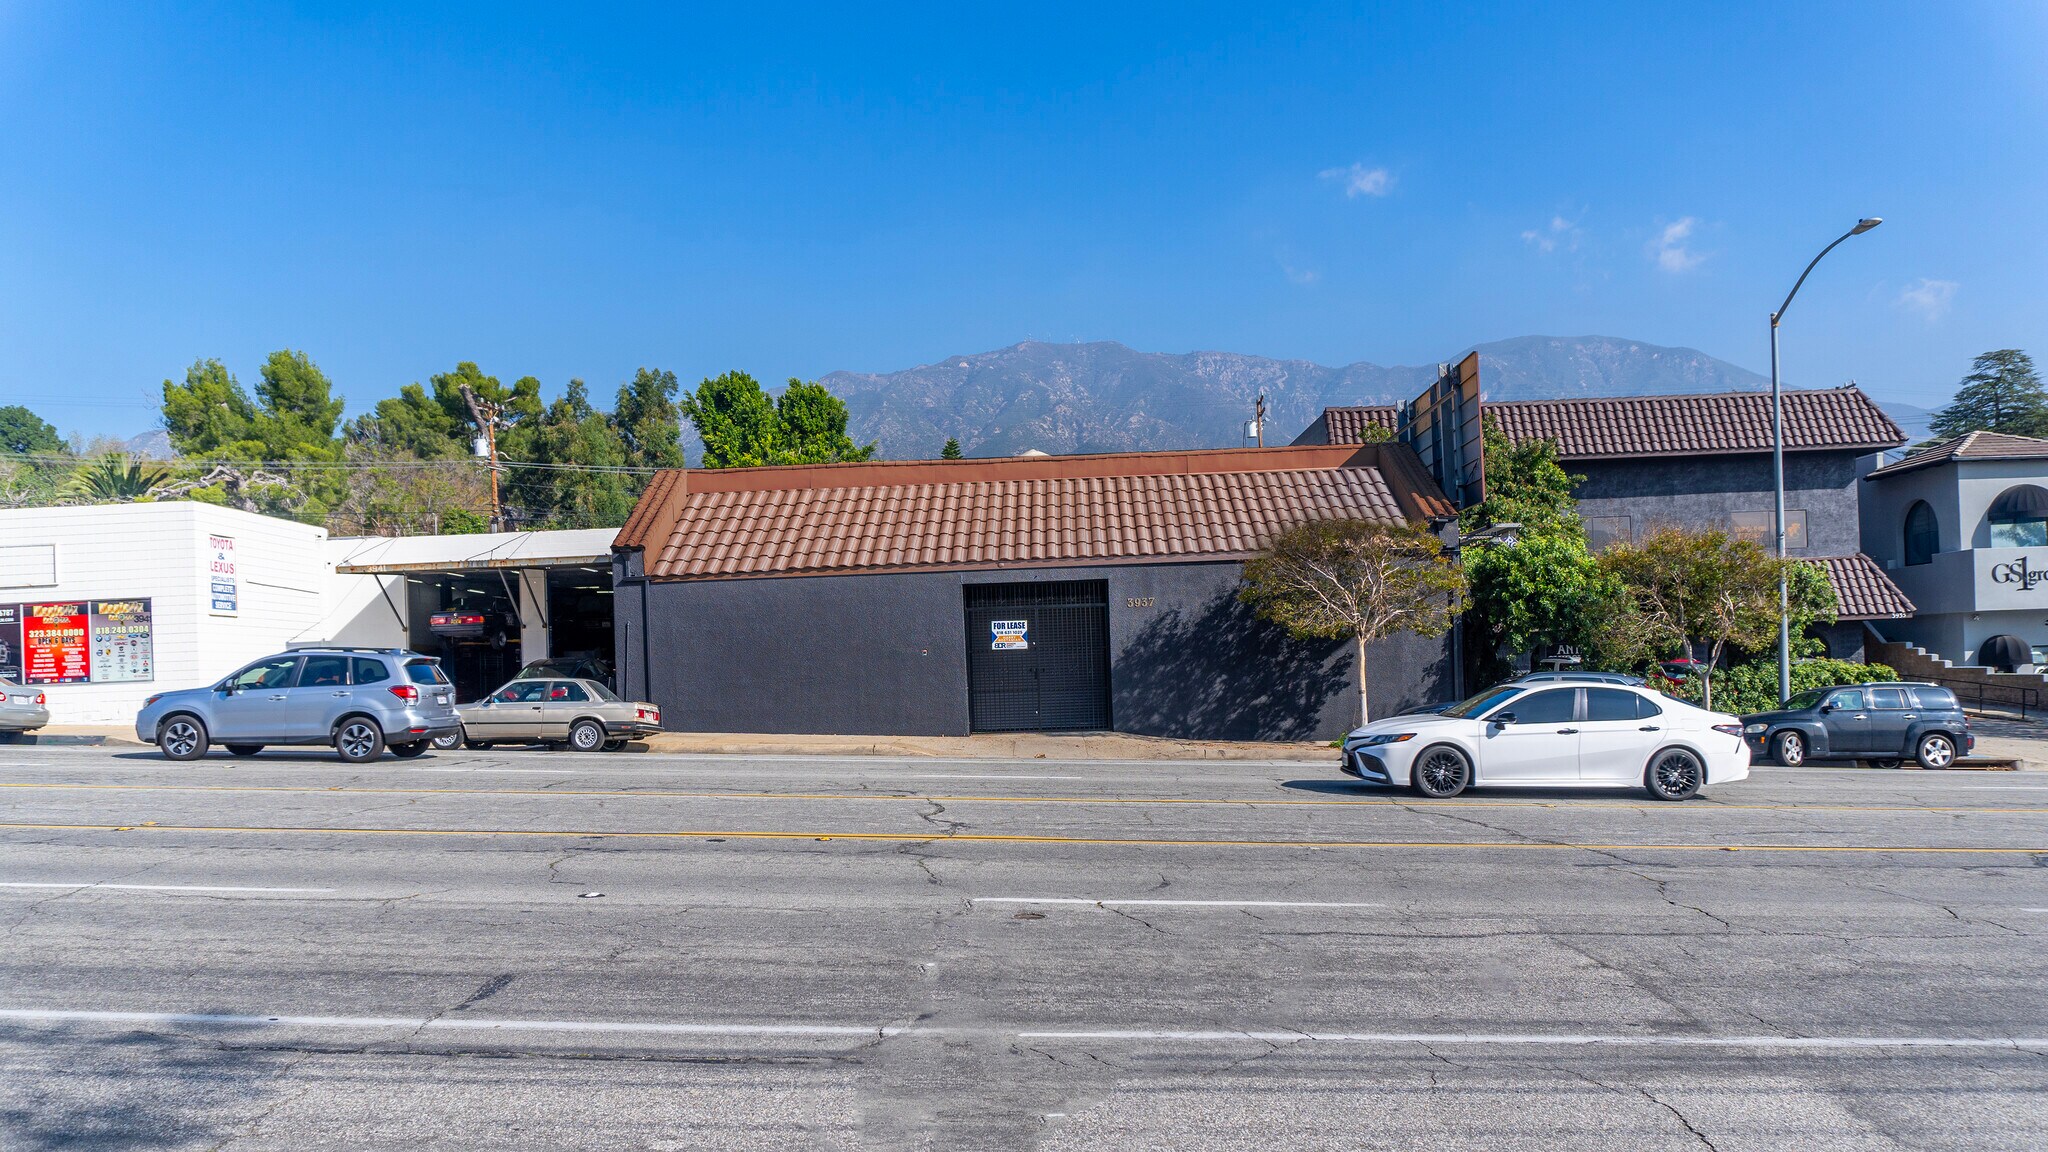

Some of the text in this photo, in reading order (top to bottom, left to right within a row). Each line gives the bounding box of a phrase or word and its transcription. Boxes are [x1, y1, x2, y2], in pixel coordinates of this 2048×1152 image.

[210, 537, 233, 551] TOYOTA
[218, 552, 225, 560] &
[210, 561, 234, 574] LEXUS
[211, 575, 235, 583] SPECIALISTS
[1127, 597, 1155, 608] 3937
[95, 625, 149, 634] 818.248.0304
[993, 621, 1026, 630] FOR LEASE
